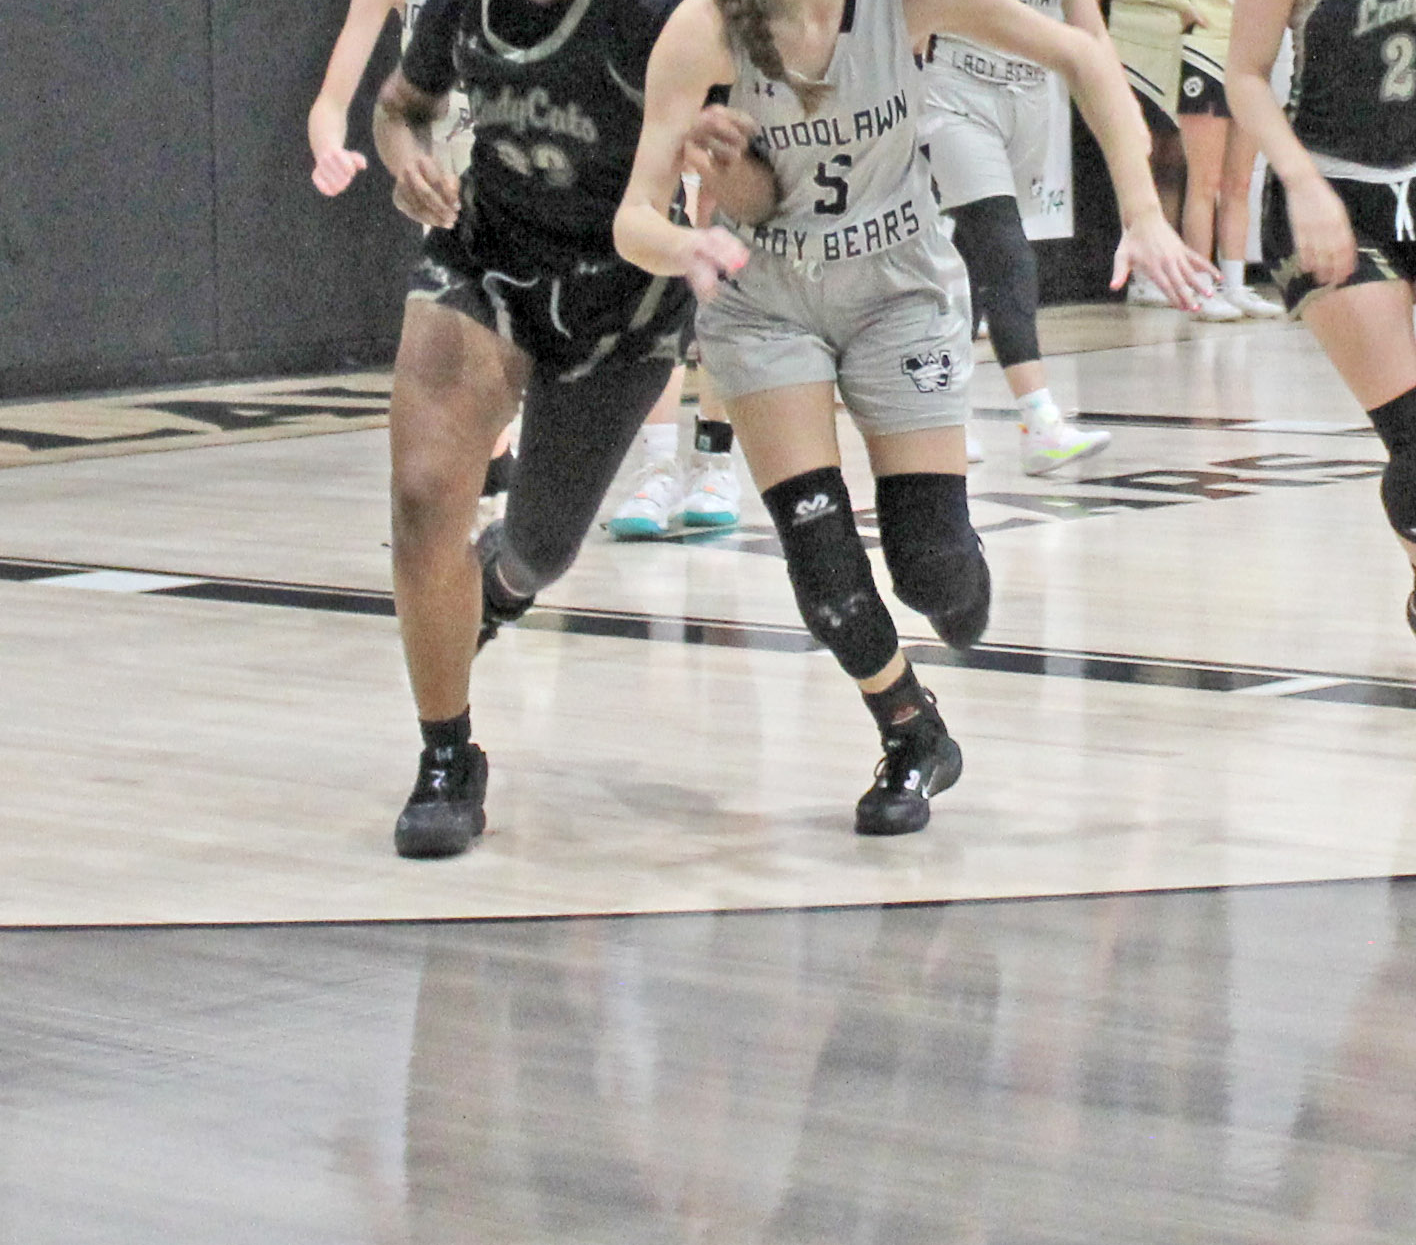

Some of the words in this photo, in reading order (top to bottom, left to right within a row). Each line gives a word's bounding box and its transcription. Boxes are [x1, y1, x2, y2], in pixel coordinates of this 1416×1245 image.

[953, 51, 995, 76] LADY
[814, 154, 852, 215] 5
[753, 221, 807, 261] ADY
[823, 200, 919, 262] BEARS
